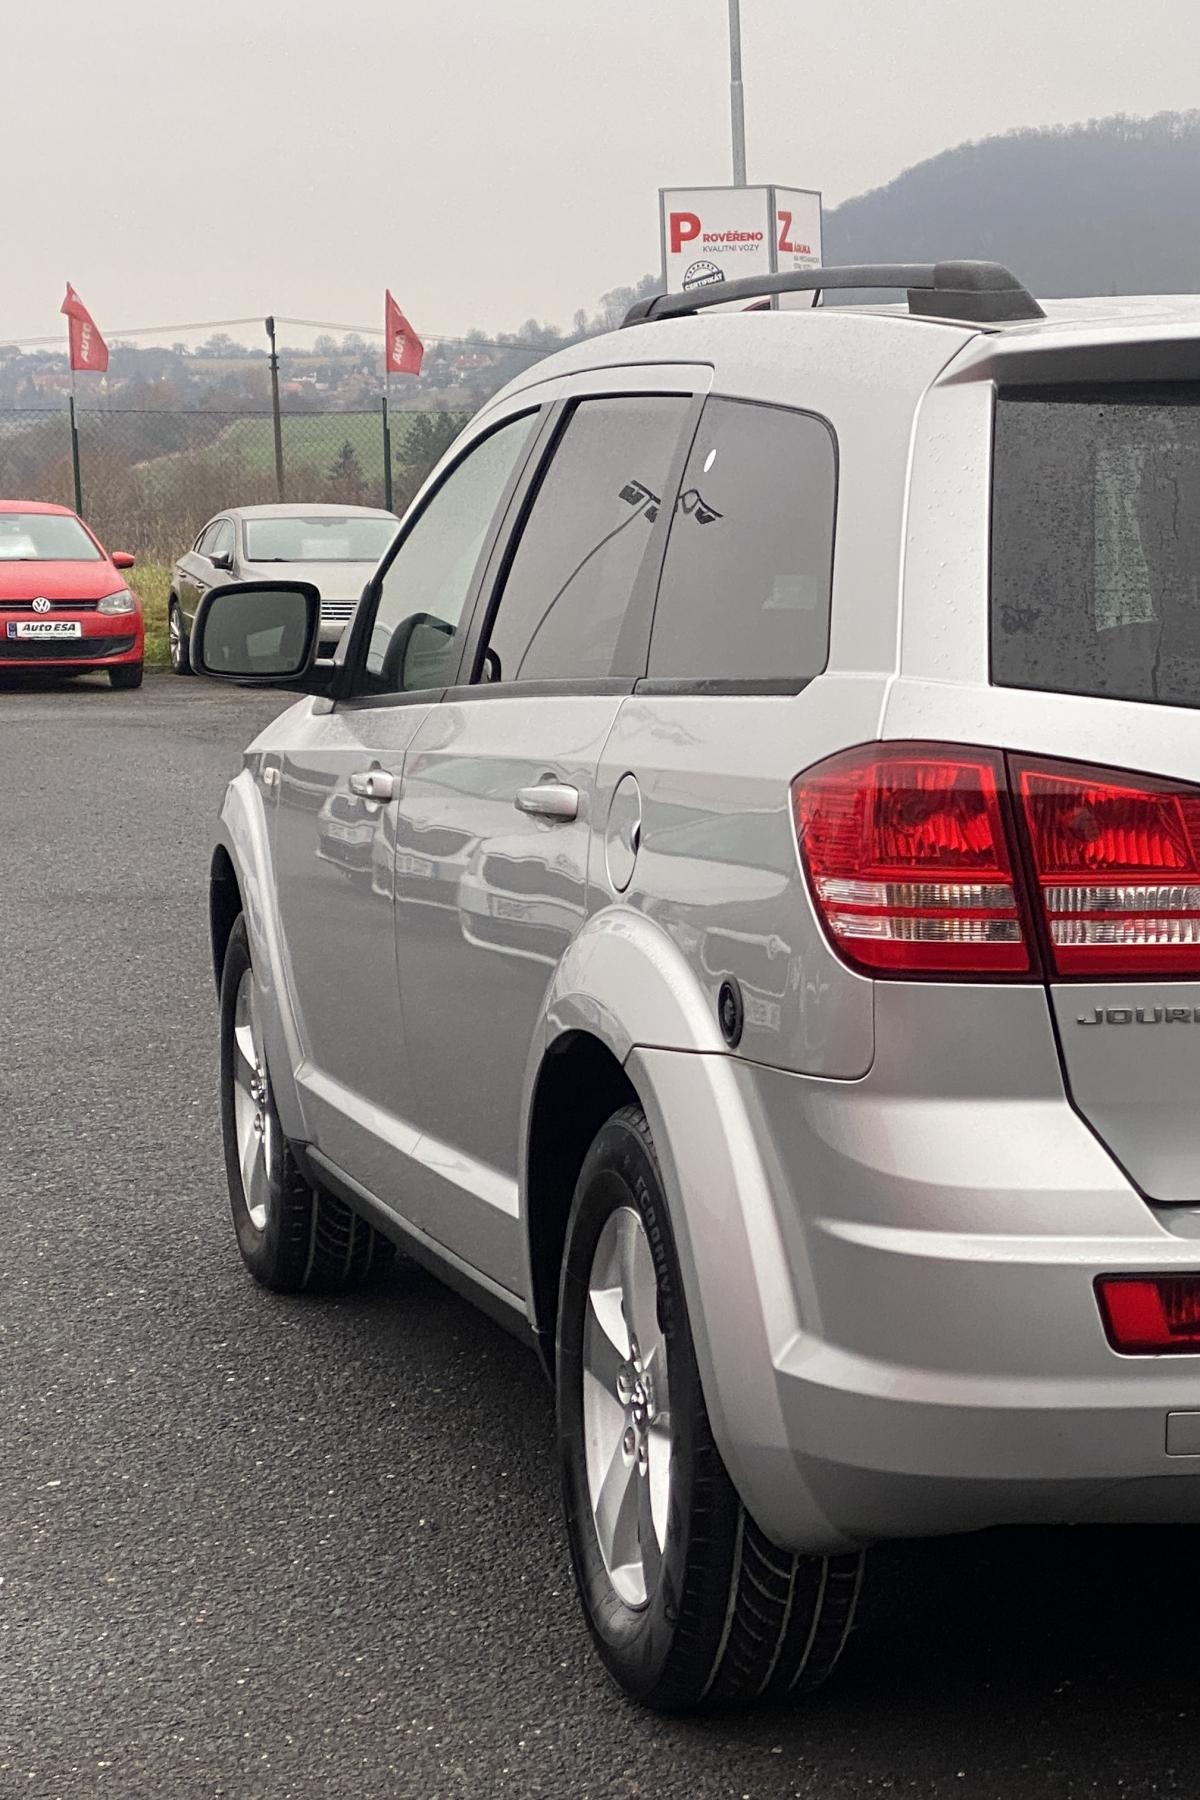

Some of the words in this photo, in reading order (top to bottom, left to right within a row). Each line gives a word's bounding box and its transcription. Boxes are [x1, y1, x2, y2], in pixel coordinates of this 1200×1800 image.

[703, 245, 737, 253] KVALITNÍ
[739, 244, 760, 252] VOZY
[22, 624, 53, 632] Auto
[54, 624, 76, 632] ESA
